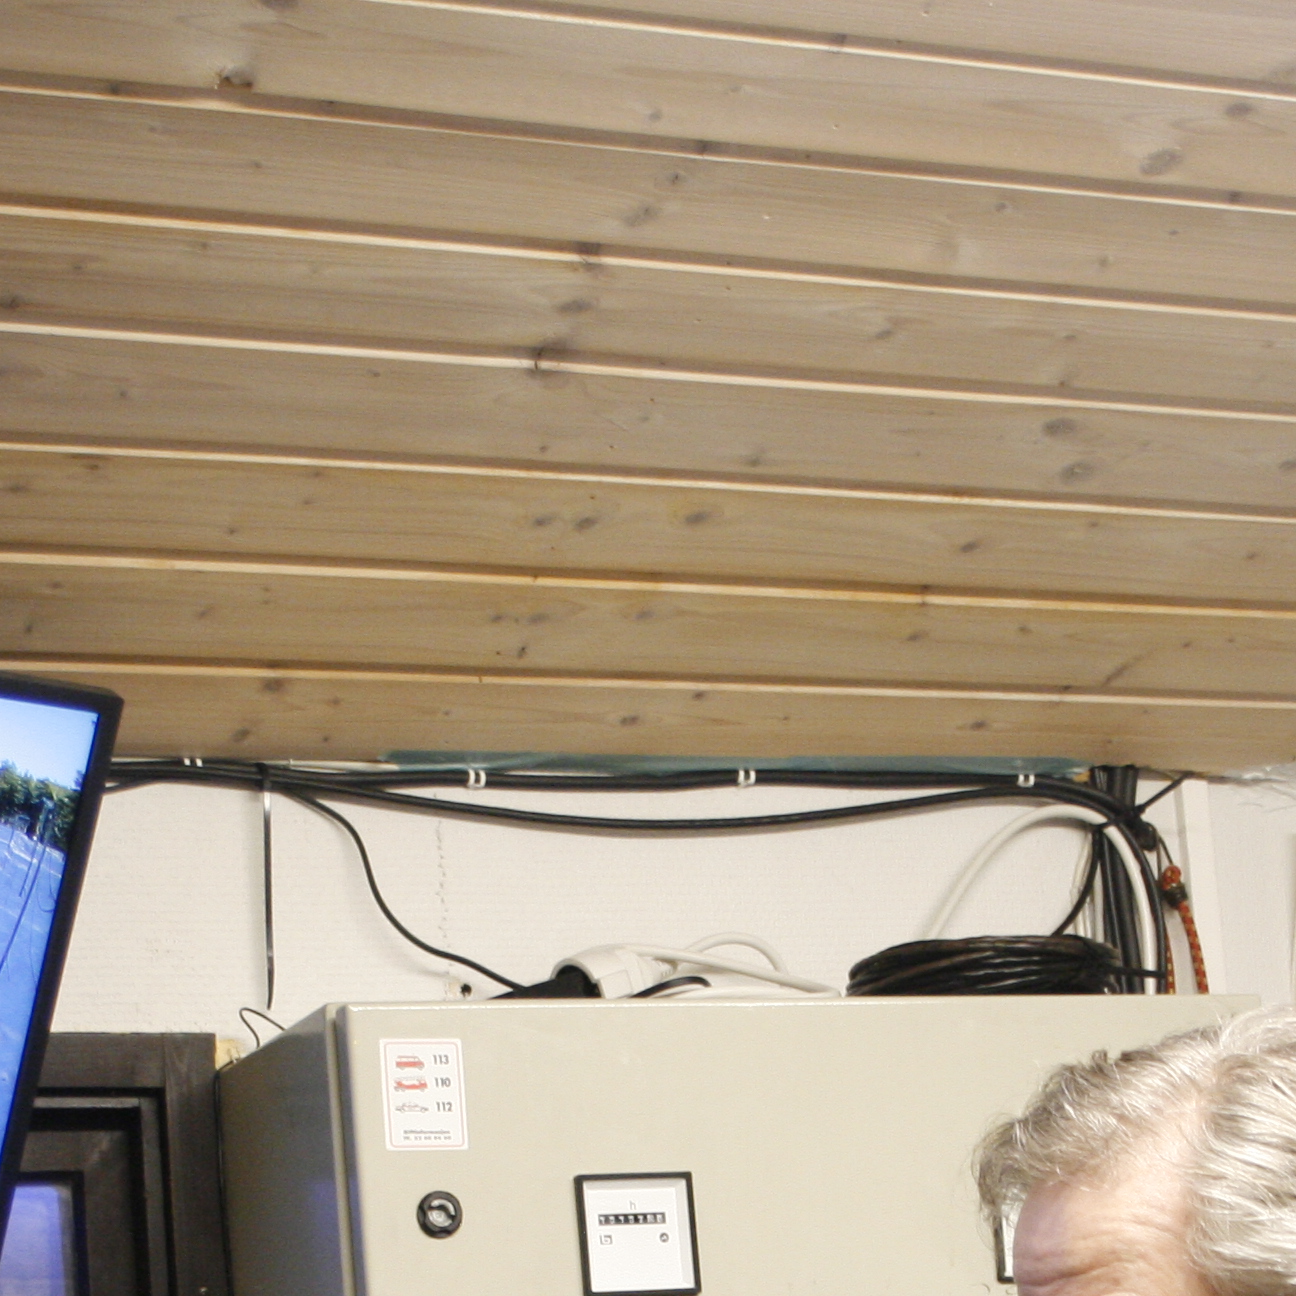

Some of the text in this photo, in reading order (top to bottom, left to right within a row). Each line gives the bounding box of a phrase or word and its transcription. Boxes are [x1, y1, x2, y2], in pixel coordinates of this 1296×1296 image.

[433, 1054, 449, 1065] 113
[434, 1077, 451, 1088] 110
[436, 1101, 453, 1112] 112
